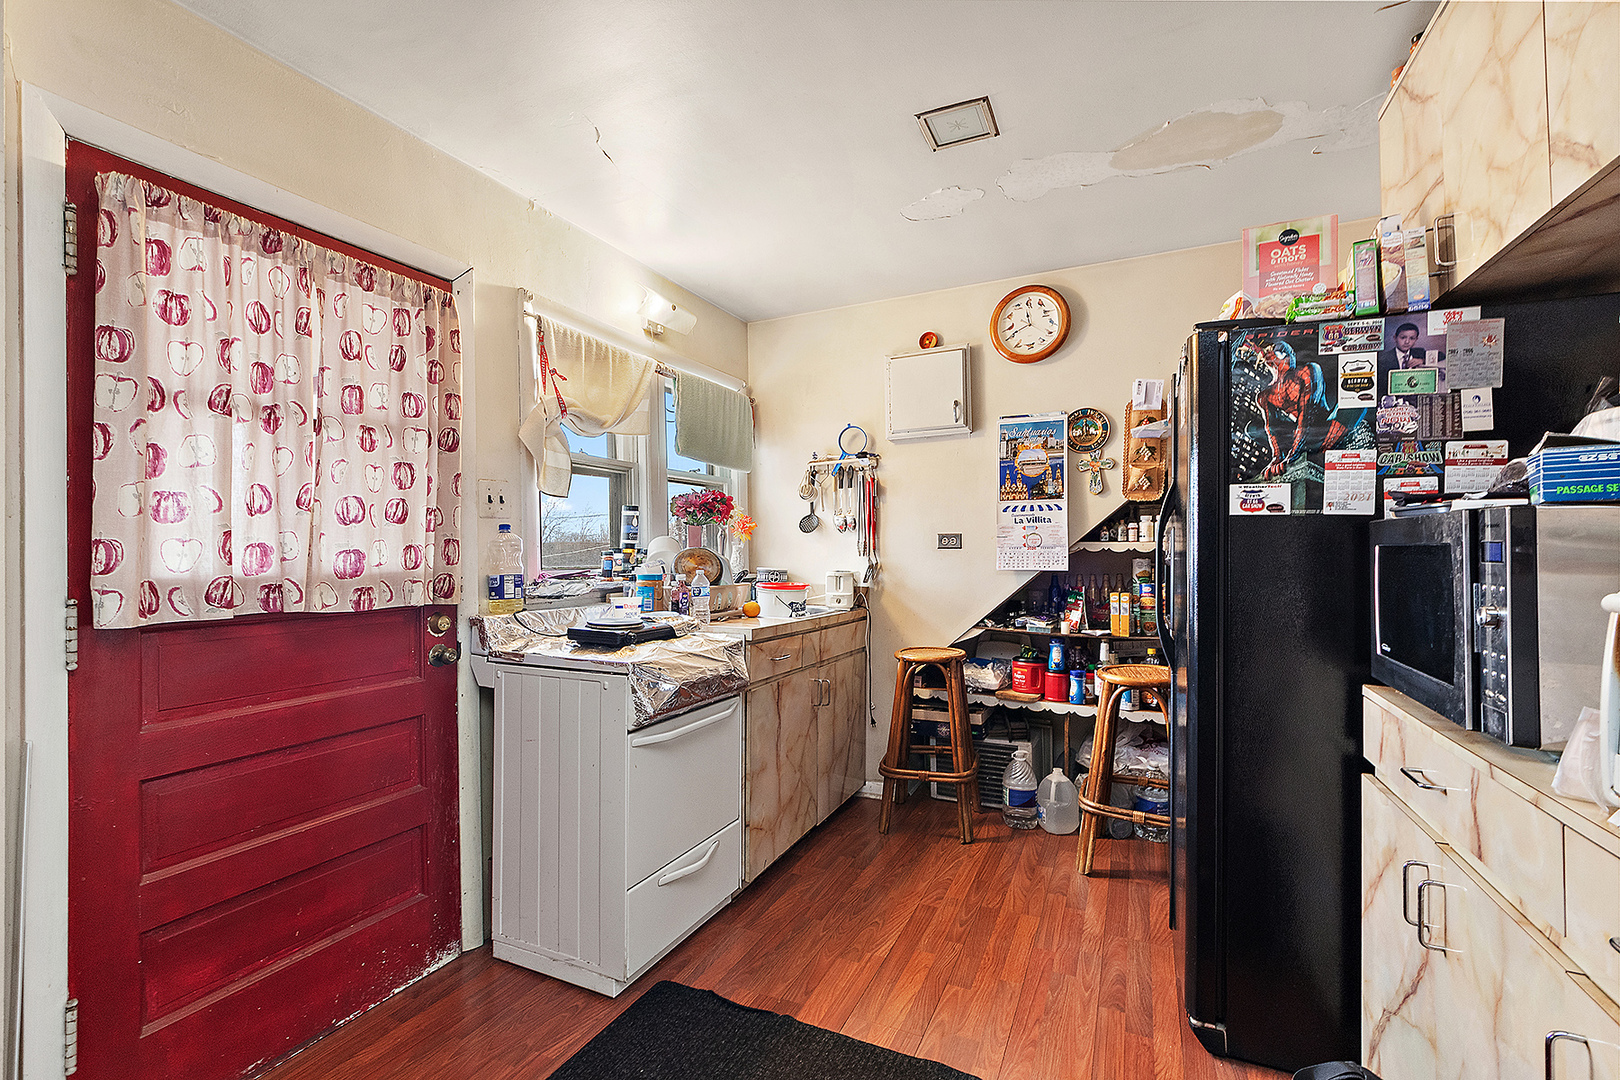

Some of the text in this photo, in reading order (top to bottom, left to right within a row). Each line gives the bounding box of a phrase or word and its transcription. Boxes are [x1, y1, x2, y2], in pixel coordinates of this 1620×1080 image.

[1270, 244, 1306, 258] OATS
[1277, 254, 1306, 264] more
[1009, 427, 1056, 437] Santuarios
[1381, 453, 1440, 464] CAR SHOW
[1557, 483, 1620, 494] PASSAGE SE
[1344, 492, 1372, 501] 2021
